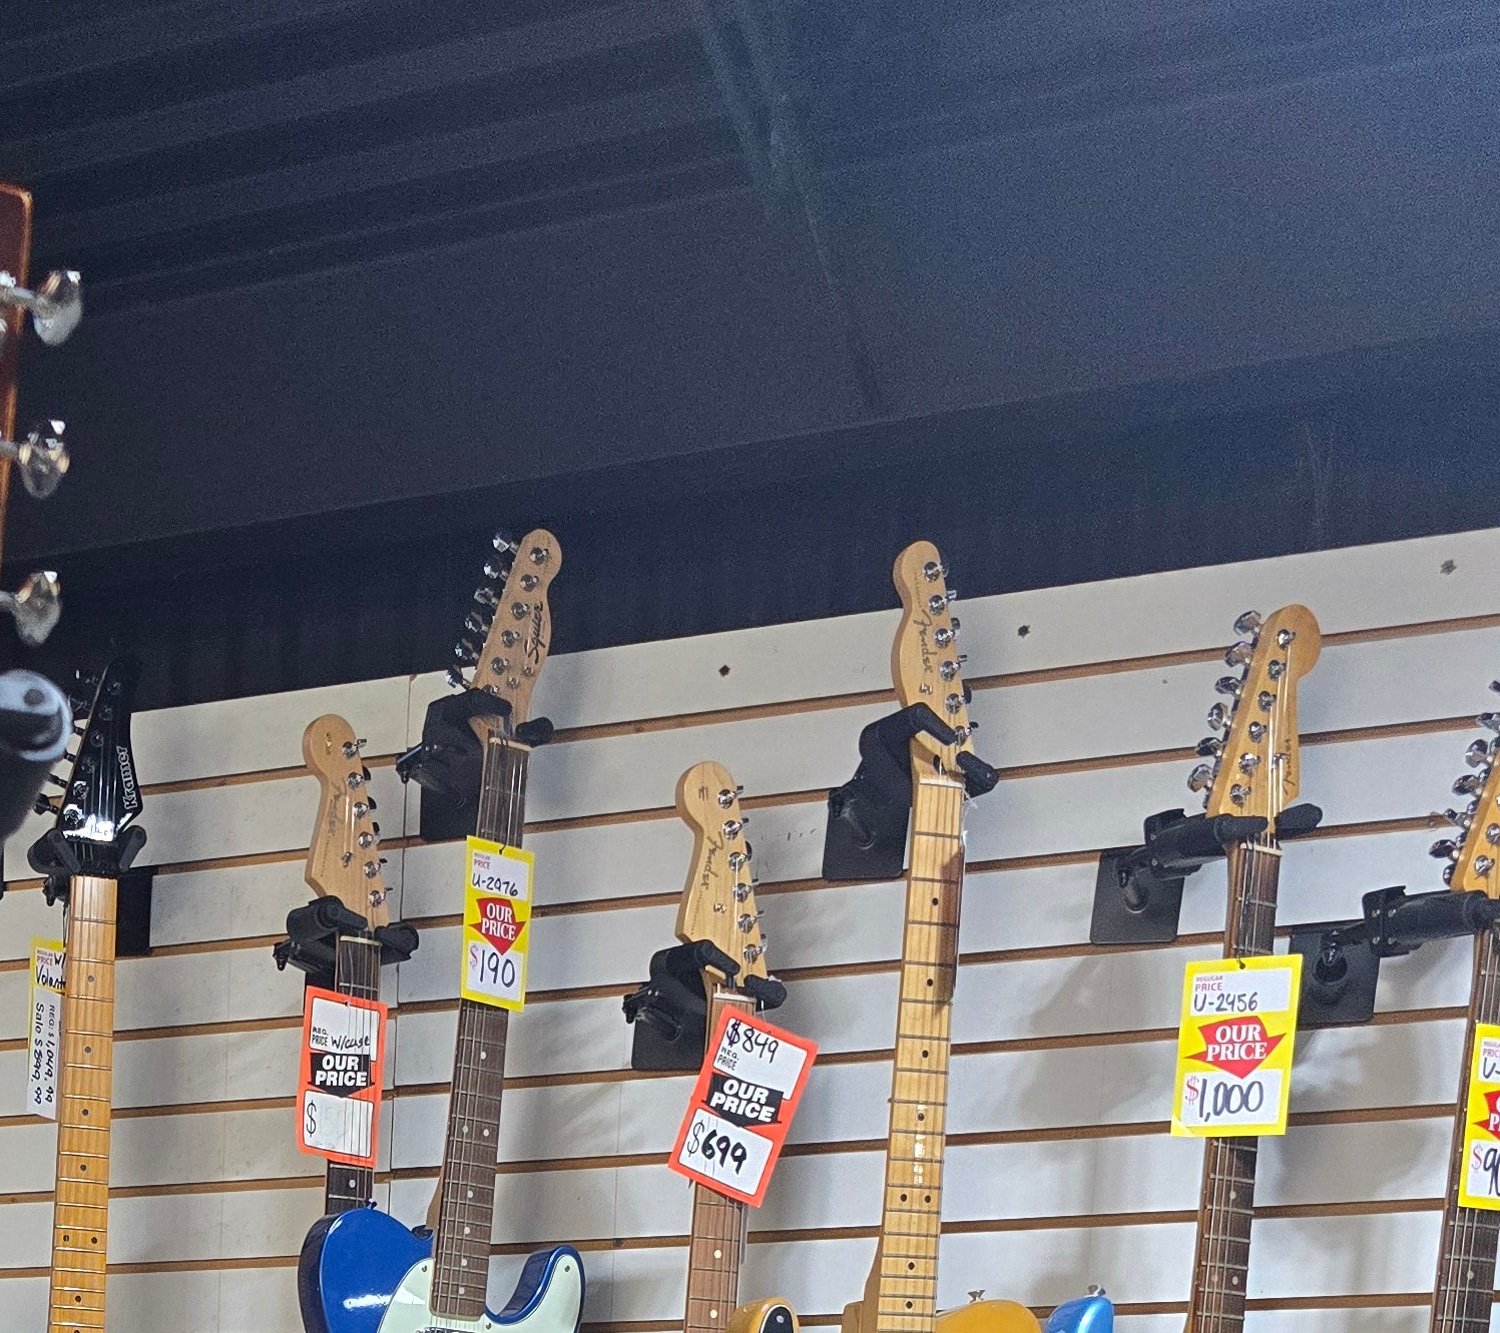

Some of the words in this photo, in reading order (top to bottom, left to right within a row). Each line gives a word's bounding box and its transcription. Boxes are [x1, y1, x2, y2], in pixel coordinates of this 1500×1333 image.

[523, 600, 546, 666] Squier
[912, 608, 939, 674] Fender
[116, 745, 138, 810] Kramer
[702, 830, 725, 891] Fender
[486, 902, 513, 924] OUR
[481, 918, 516, 941] PRICE
[469, 944, 516, 988] $190
[1194, 982, 1223, 993] PRICE
[1193, 991, 1259, 1014] U-2456
[311, 1034, 329, 1048] PRICE
[726, 1019, 780, 1065] $849
[1215, 1024, 1262, 1044] OUR
[322, 1054, 360, 1072] OUR
[716, 1055, 738, 1072] PRICE
[1205, 1042, 1268, 1063] PRICE
[315, 1070, 368, 1088] PRICE
[722, 1079, 770, 1105] OUR
[709, 1091, 776, 1123] PRICE
[686, 1119, 748, 1176] $699
